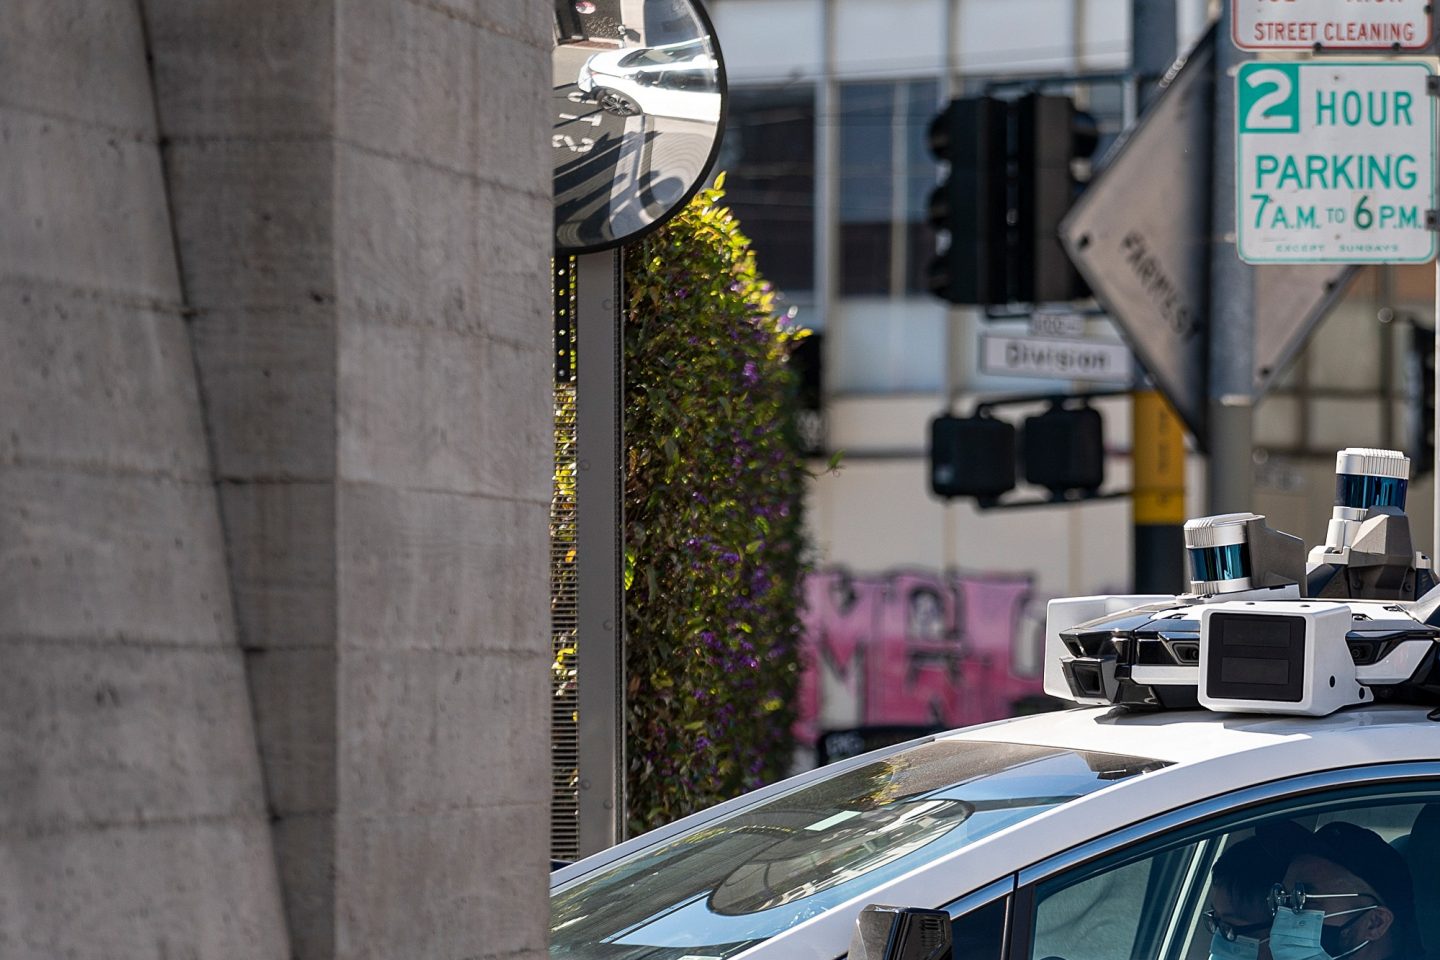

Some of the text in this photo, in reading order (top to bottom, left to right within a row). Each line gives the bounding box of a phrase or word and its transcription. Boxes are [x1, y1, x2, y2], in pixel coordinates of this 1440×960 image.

[1254, 22, 1415, 41] STREET CLEANING
[1245, 68, 1413, 129] 2 HOUR
[1255, 154, 1418, 190] PARKING
[1326, 208, 1346, 225] TO
[1275, 244, 1399, 253] EXCEPT SUNDAYS
[1006, 341, 1109, 370] Division
